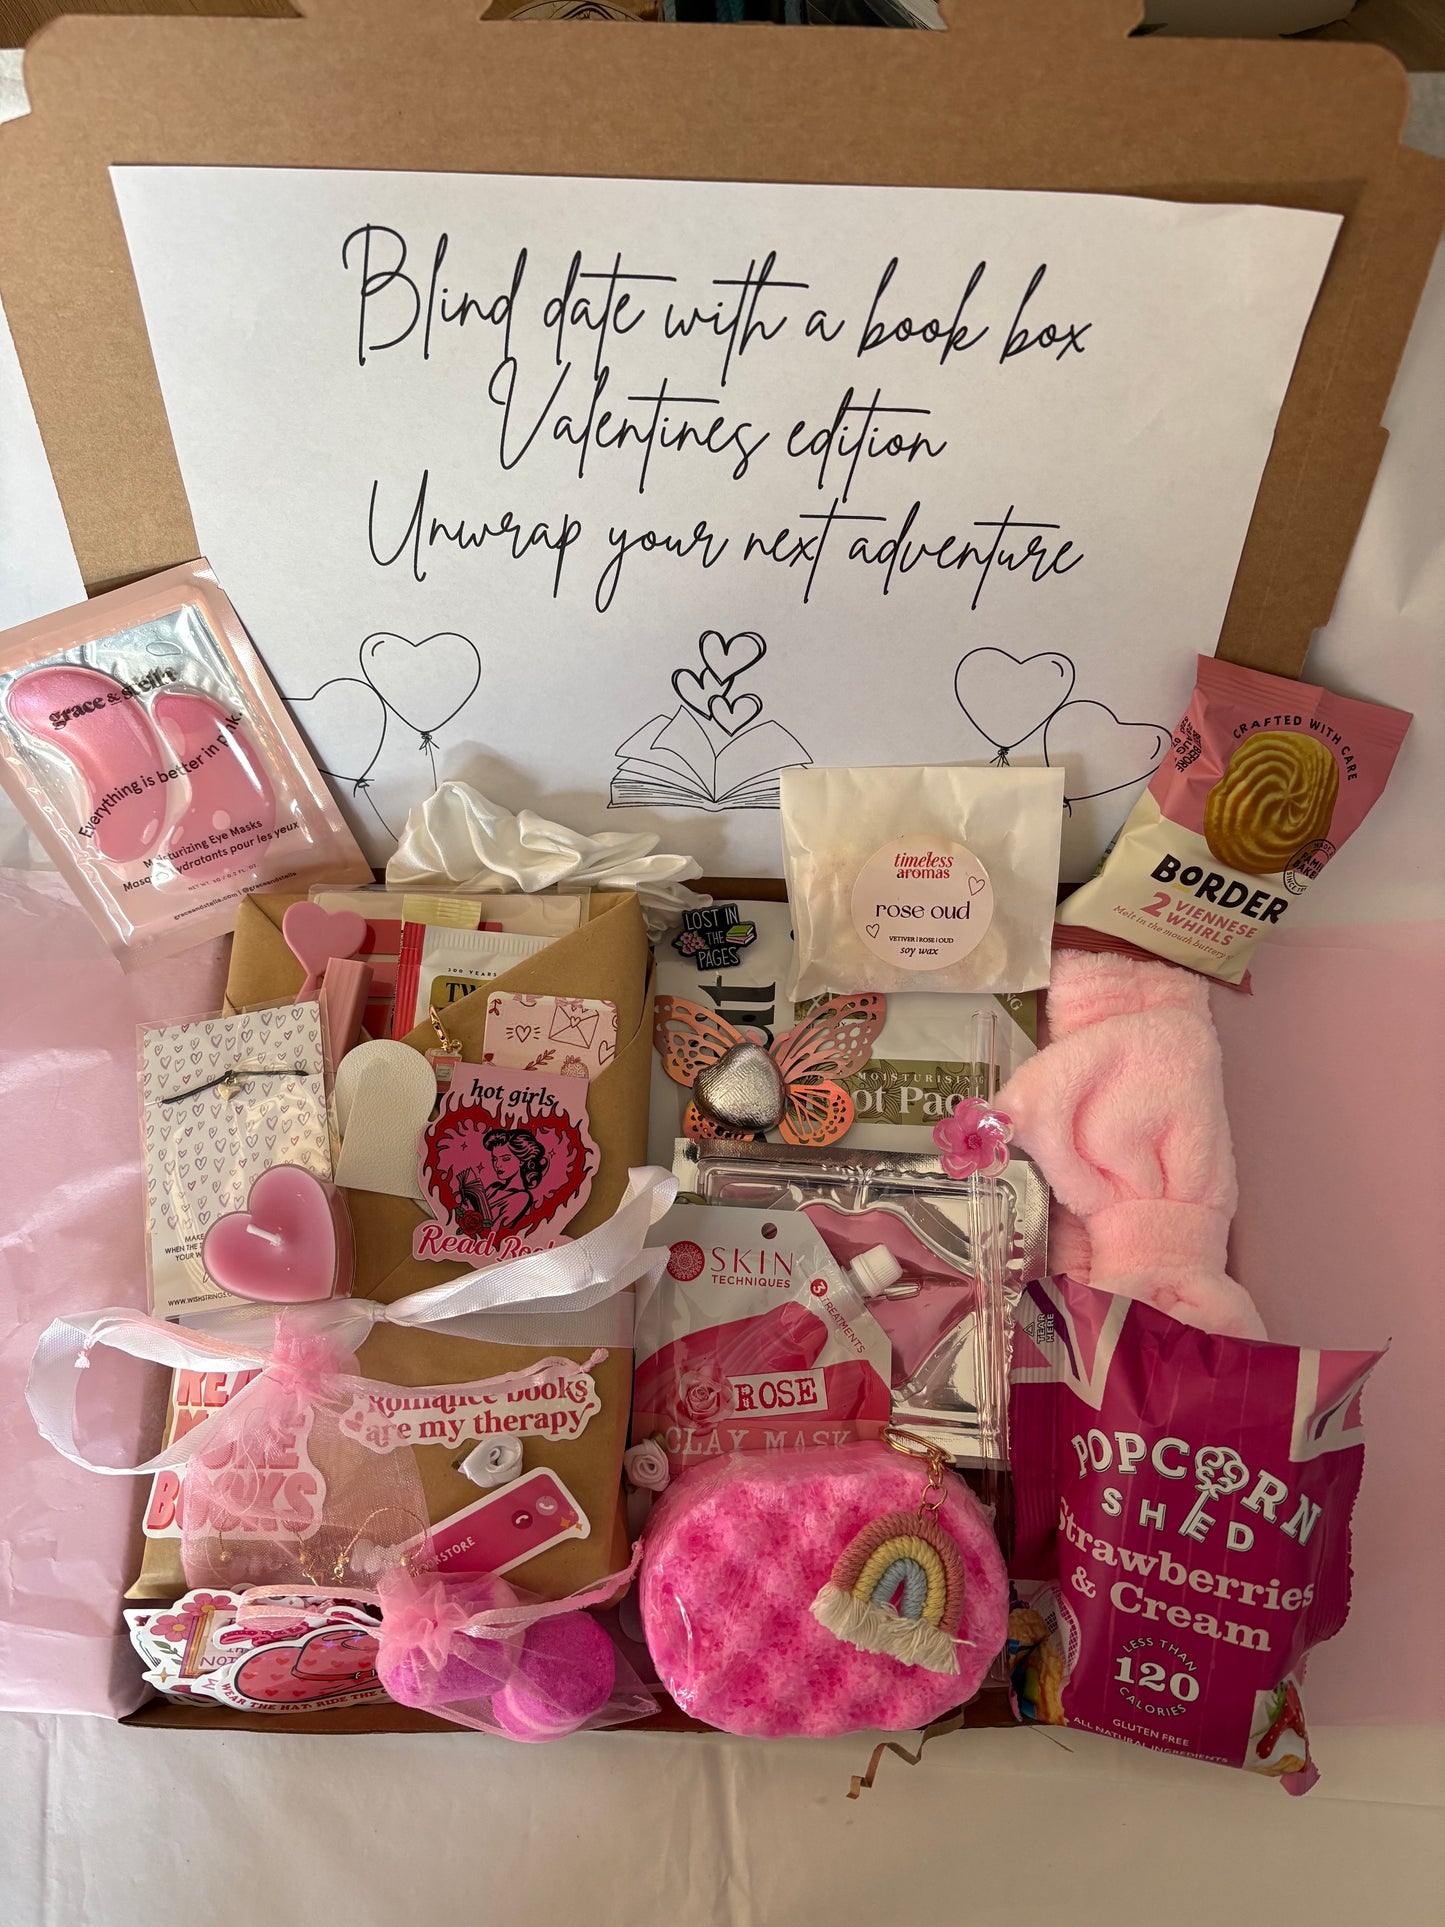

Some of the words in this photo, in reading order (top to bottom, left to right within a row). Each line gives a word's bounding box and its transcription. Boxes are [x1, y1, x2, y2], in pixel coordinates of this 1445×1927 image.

[343, 224, 527, 365] Blind
[543, 251, 677, 380] date
[664, 251, 809, 387] with
[805, 299, 845, 342] a
[857, 258, 989, 364] book
[999, 264, 1092, 364] box
[489, 357, 770, 494] Valentines
[787, 387, 947, 503] edition
[368, 470, 582, 598] Unwrap
[598, 518, 728, 612] your
[744, 498, 886, 604] next
[849, 501, 1083, 610] adventure
[49, 696, 106, 730] grace
[1175, 744, 1202, 773] BEFORE
[1233, 715, 1302, 739] CRAFTED
[1309, 718, 1342, 745] WITH
[1340, 746, 1358, 781] CARE
[78, 780, 142, 838] Everything
[140, 775, 155, 788] is
[156, 755, 204, 784] better
[204, 743, 220, 758] in
[217, 711, 244, 747] pnk.
[172, 849, 228, 874] ydratants
[229, 838, 254, 855] pour
[257, 832, 273, 844] les
[274, 821, 300, 838] yeux
[209, 832, 229, 846] Eye
[229, 820, 263, 837] Masks
[894, 851, 954, 868] timeless
[896, 868, 950, 879] aromas
[1140, 891, 1171, 918] 2
[1150, 853, 1289, 925] BORDER
[685, 909, 719, 931] LOST
[725, 906, 739, 925] IN
[875, 904, 925, 919] rose
[930, 901, 970, 920] oud
[1176, 900, 1258, 939] VIENNESE
[705, 930, 725, 945] THE
[1113, 905, 1136, 919] Melt
[1136, 917, 1147, 926] in
[1147, 922, 1163, 933] the
[1163, 928, 1193, 945] mouth
[1192, 940, 1226, 961] buttery
[1166, 912, 1233, 946] WHIRLS
[698, 947, 739, 969] PAGES
[900, 946, 916, 957] soy
[918, 947, 939, 955] wax
[471, 1079, 505, 1101] hot
[508, 1086, 558, 1108] girls
[165, 1246, 184, 1254] WHEN
[184, 1234, 204, 1242] MAKE
[418, 1224, 494, 1257] Read
[175, 1253, 194, 1261] YOUR
[711, 1246, 794, 1277] SKIN
[711, 1274, 792, 1289] TECHNIQUES
[813, 1281, 826, 1294] 3
[821, 1295, 867, 1354] TREATMENTS
[1036, 1312, 1046, 1344] TEAR
[1046, 1312, 1055, 1343] HERE
[507, 1376, 588, 1403] books
[733, 1376, 818, 1413] ROSE
[365, 1421, 411, 1448] are
[419, 1418, 466, 1443] my
[473, 1402, 595, 1435] therapy
[665, 1426, 749, 1456] CLAY
[764, 1430, 852, 1450] MASK
[1101, 1487, 1255, 1552] SHED
[1058, 1496, 1314, 1612] Strawberries
[1071, 1565, 1097, 1599] &
[1110, 1580, 1271, 1653] Cream
[1122, 1637, 1154, 1654] LESS
[1160, 1639, 1198, 1672] THAN
[1113, 1656, 1200, 1702] 120
[220, 1682, 247, 1706] WEAR
[250, 1702, 276, 1711] THE
[316, 1695, 349, 1708] RIDE
[351, 1690, 378, 1701] THE
[1119, 1686, 1187, 1717] CALORIES
[1073, 1716, 1094, 1729] ALL
[1095, 1725, 1147, 1749] NATURAL
[1151, 1745, 1229, 1763] INGREDIENTS
[1112, 1718, 1159, 1739] GLUTEN
[1162, 1733, 1190, 1747] FREE
